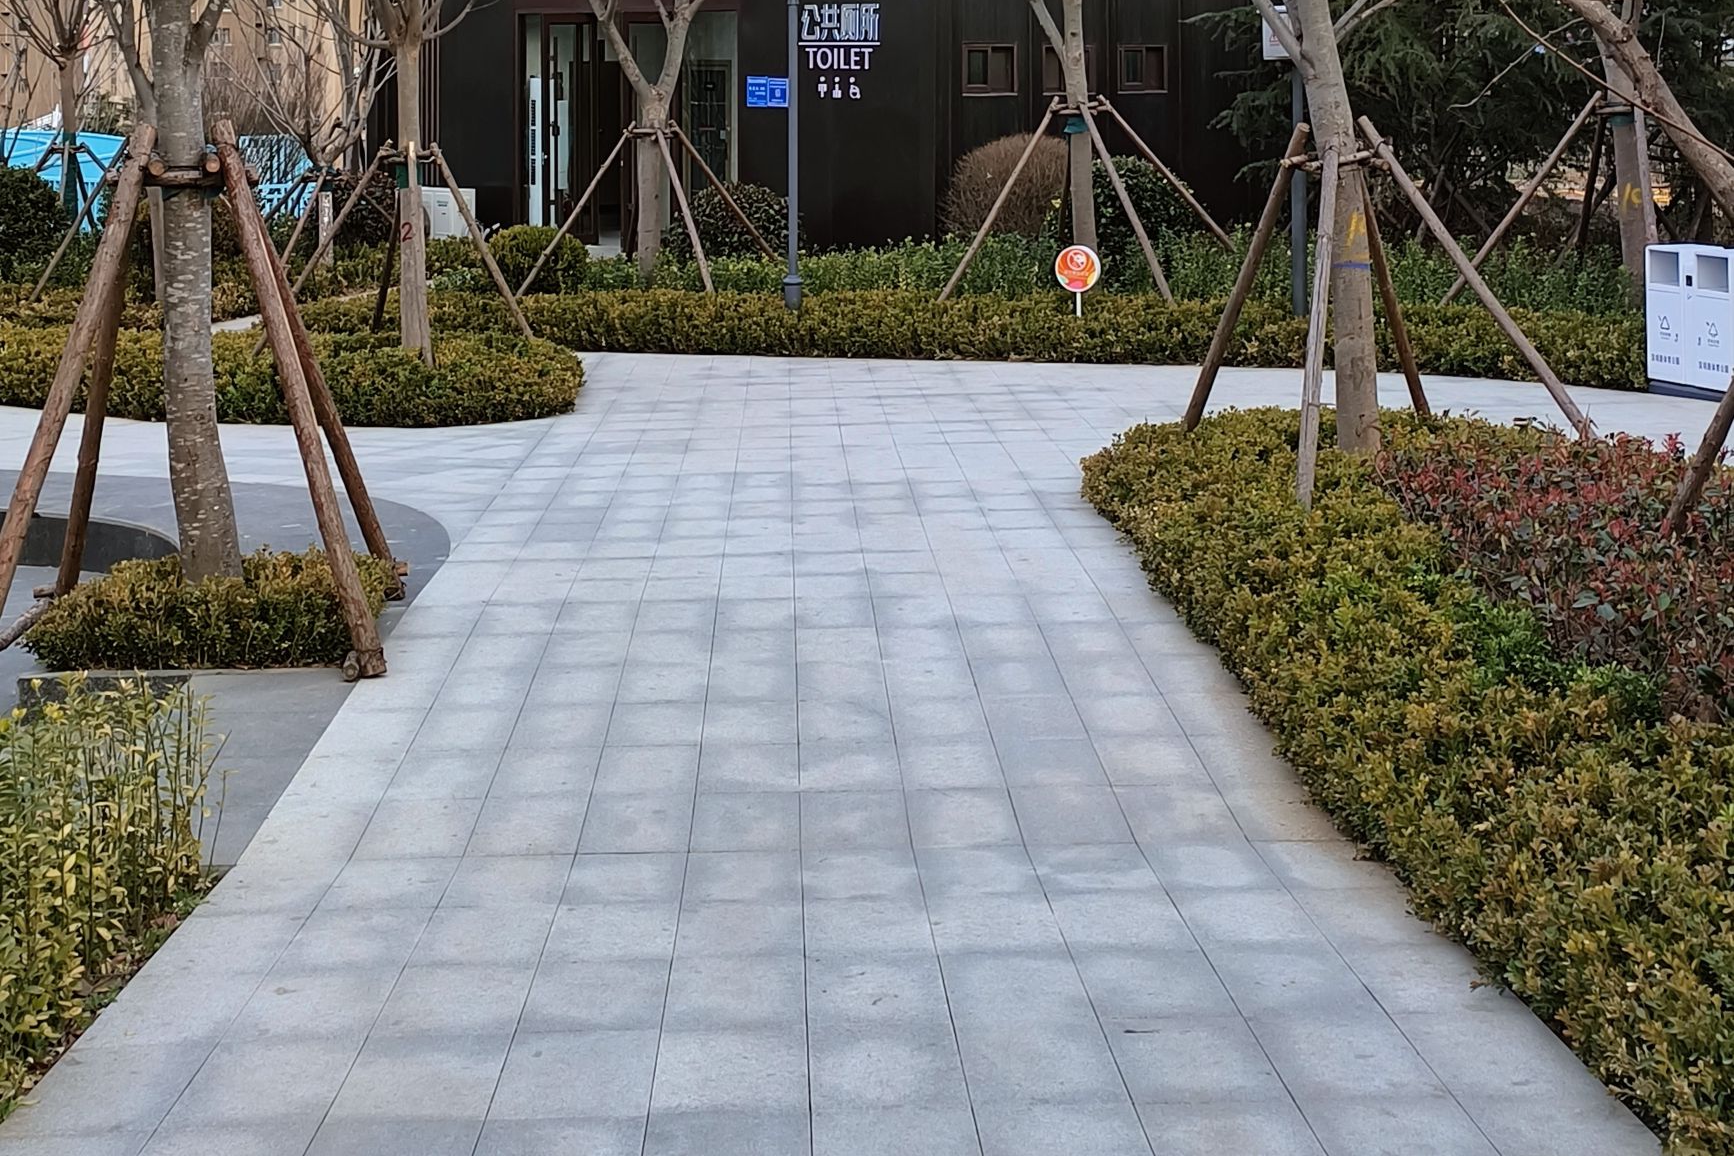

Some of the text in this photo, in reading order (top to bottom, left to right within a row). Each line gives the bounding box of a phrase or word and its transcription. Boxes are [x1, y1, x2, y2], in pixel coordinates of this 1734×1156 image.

[801, 3, 880, 41] 公共厕所
[805, 48, 873, 69] TOILET
[401, 221, 413, 243] 2
